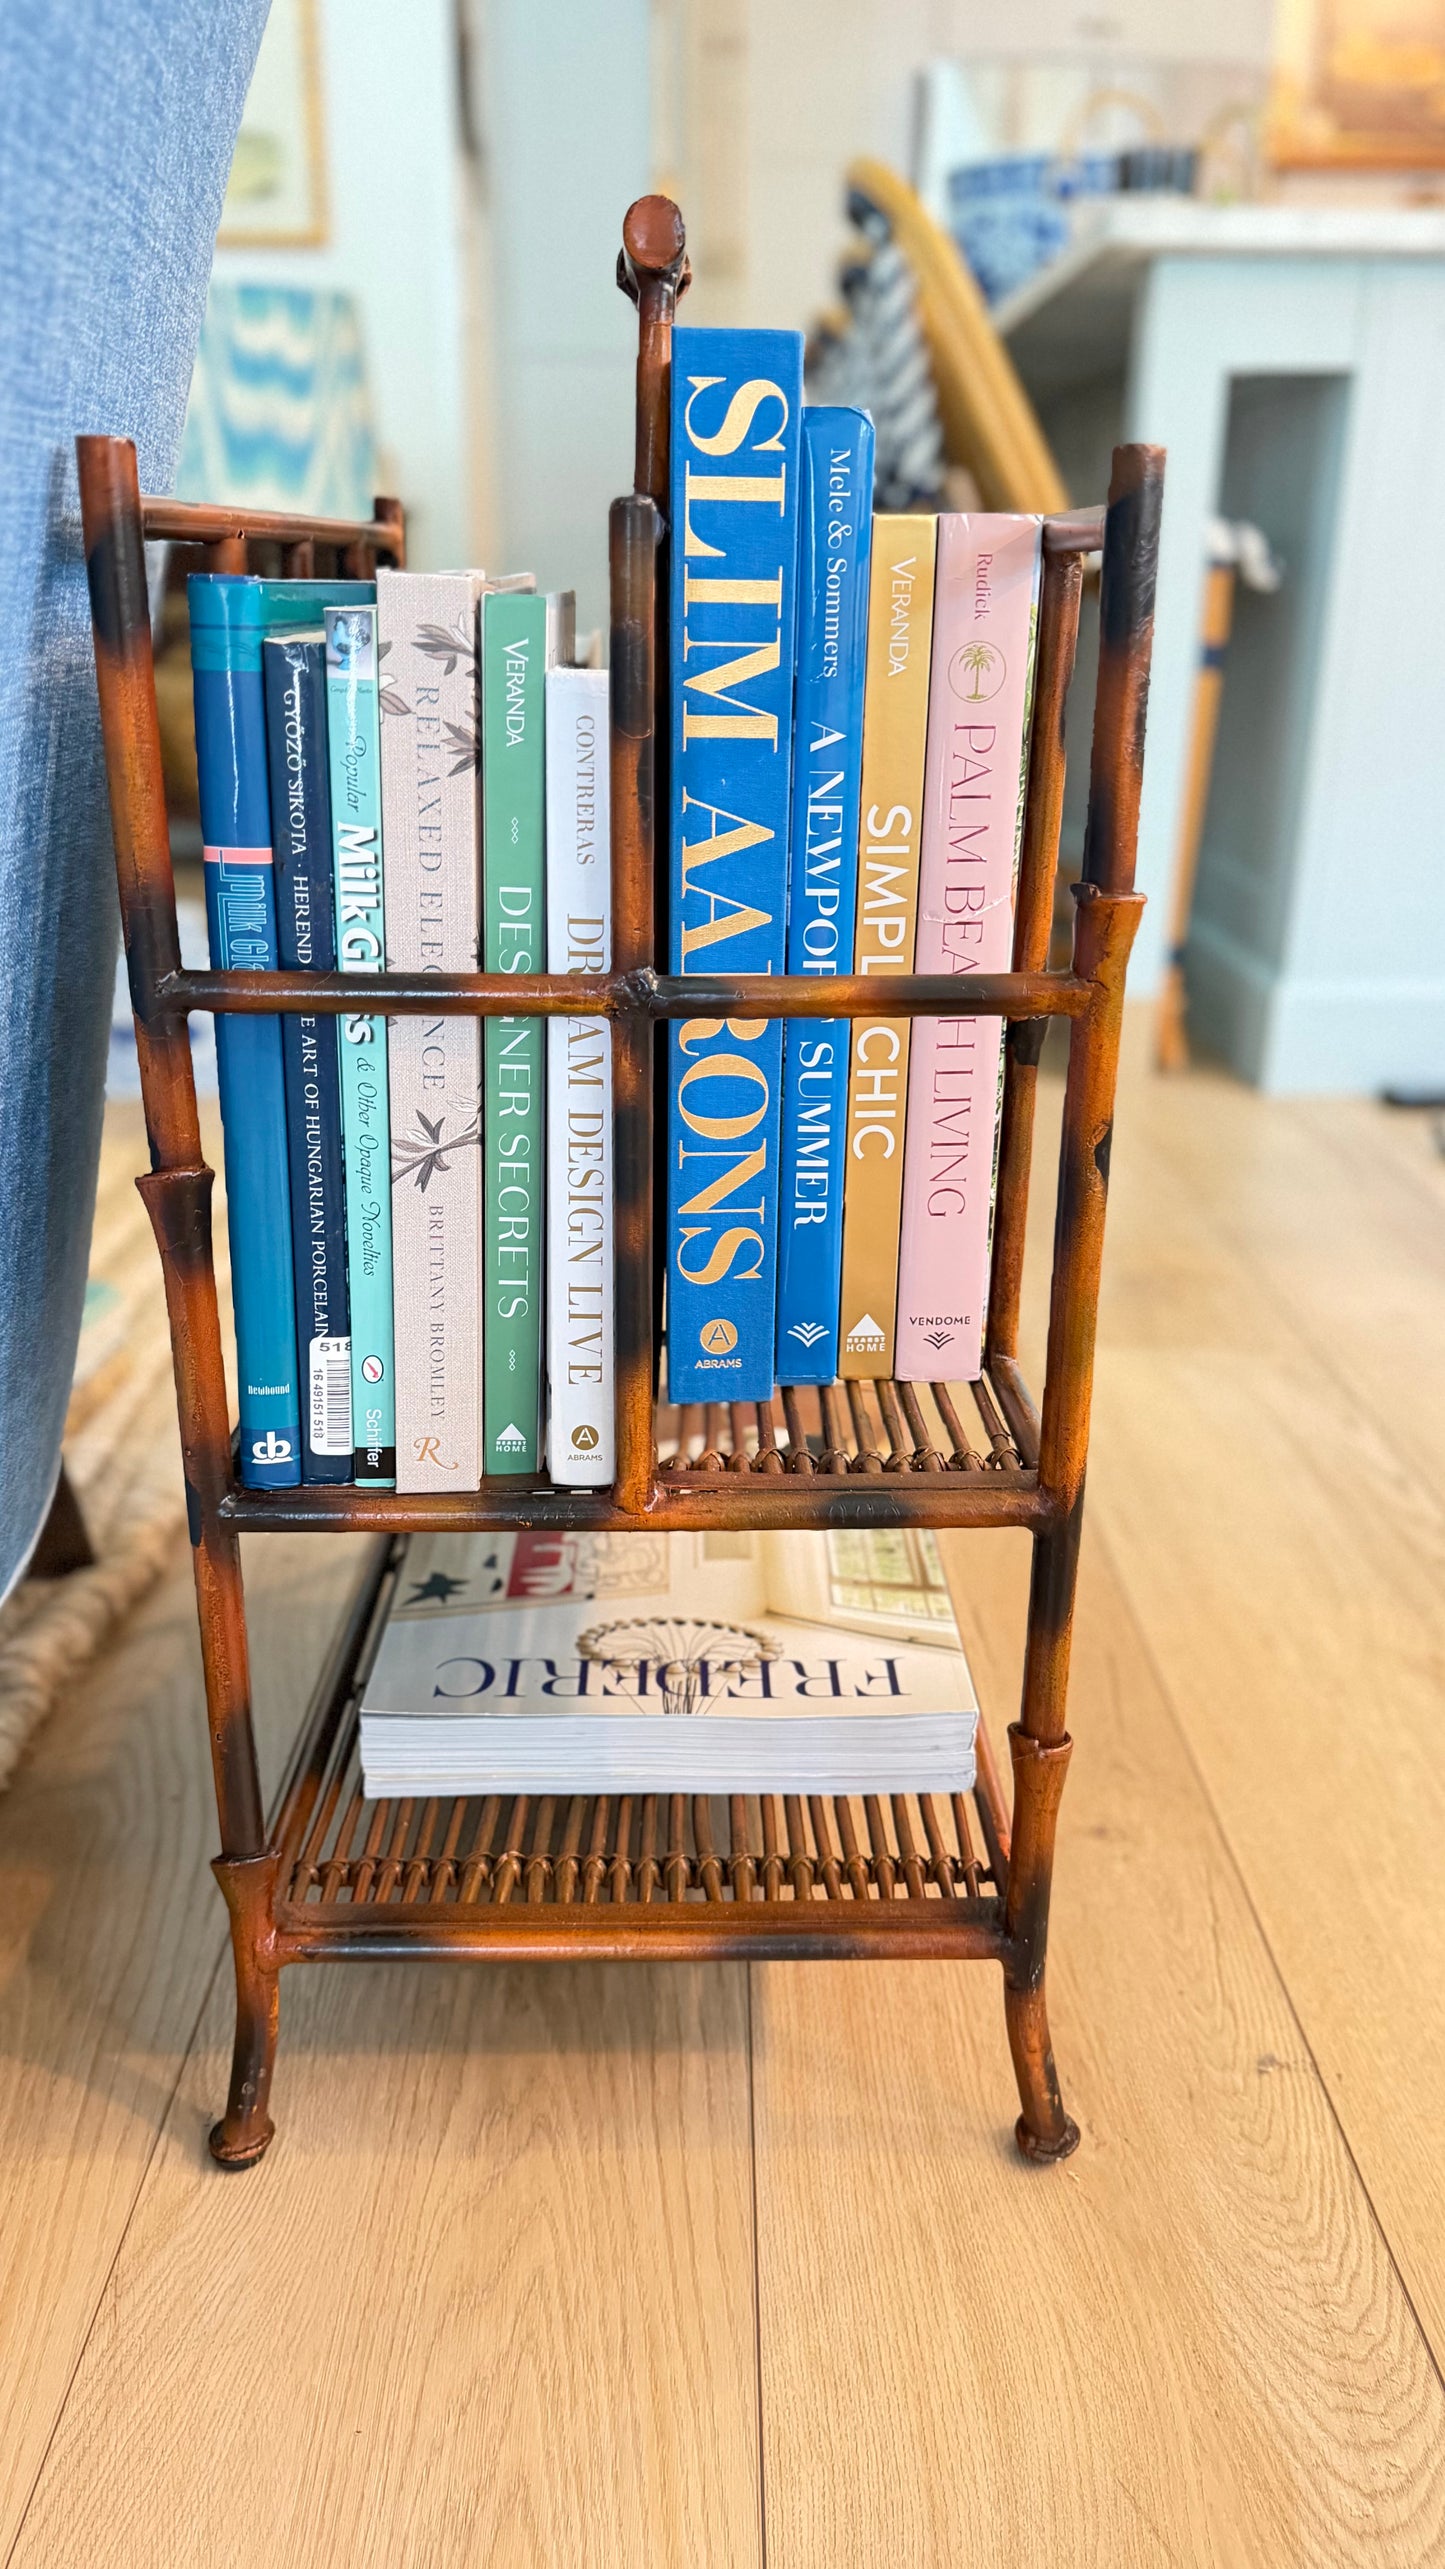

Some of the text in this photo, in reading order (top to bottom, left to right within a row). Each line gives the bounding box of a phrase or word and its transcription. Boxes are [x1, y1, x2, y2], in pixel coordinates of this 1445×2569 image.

[823, 448, 853, 679] Mele & Sommers
[974, 553, 993, 620] Rudick
[887, 556, 917, 677] VERANDA
[283, 688, 306, 772] GYŐZŐ
[502, 638, 530, 748] VERANDA
[340, 735, 367, 813] Popular
[810, 721, 847, 752] A
[287, 779, 308, 855] SIKOTA
[576, 714, 595, 865] CONTRERAS
[677, 375, 789, 1285] SLIM AARONS
[293, 876, 312, 964] HEREND
[415, 686, 446, 1090] RELAXED ELENCE
[338, 820, 382, 1043] Milk Gls
[927, 724, 996, 1217] PALM BEAH LIVING
[853, 804, 912, 1160] SIMPL CHIC
[302, 1034, 318, 1076] ART
[304, 1083, 319, 1110] OF
[498, 886, 532, 1318] DESNER SECRETS
[794, 1041, 834, 1230] SUMMER
[306, 1115, 325, 1234] HUNGARIAN
[356, 1057, 381, 1276] & Other Opaque Novelties
[566, 914, 605, 1385] DRAM DESIGN LIVE
[429, 1205, 446, 1419] BRITTANY BROMLEY
[708, 1324, 731, 1346] A
[846, 1343, 886, 1352] HOME
[909, 1316, 971, 1326] VENDOME
[313, 1368, 324, 1381] 16
[695, 1358, 742, 1369] ABRAMS
[313, 1419, 324, 1439] 518
[366, 1408, 383, 1468] Schiffer
[413, 1437, 459, 1470] R
[576, 1428, 595, 1445] A
[433, 1656, 911, 1699] FREDERIC
